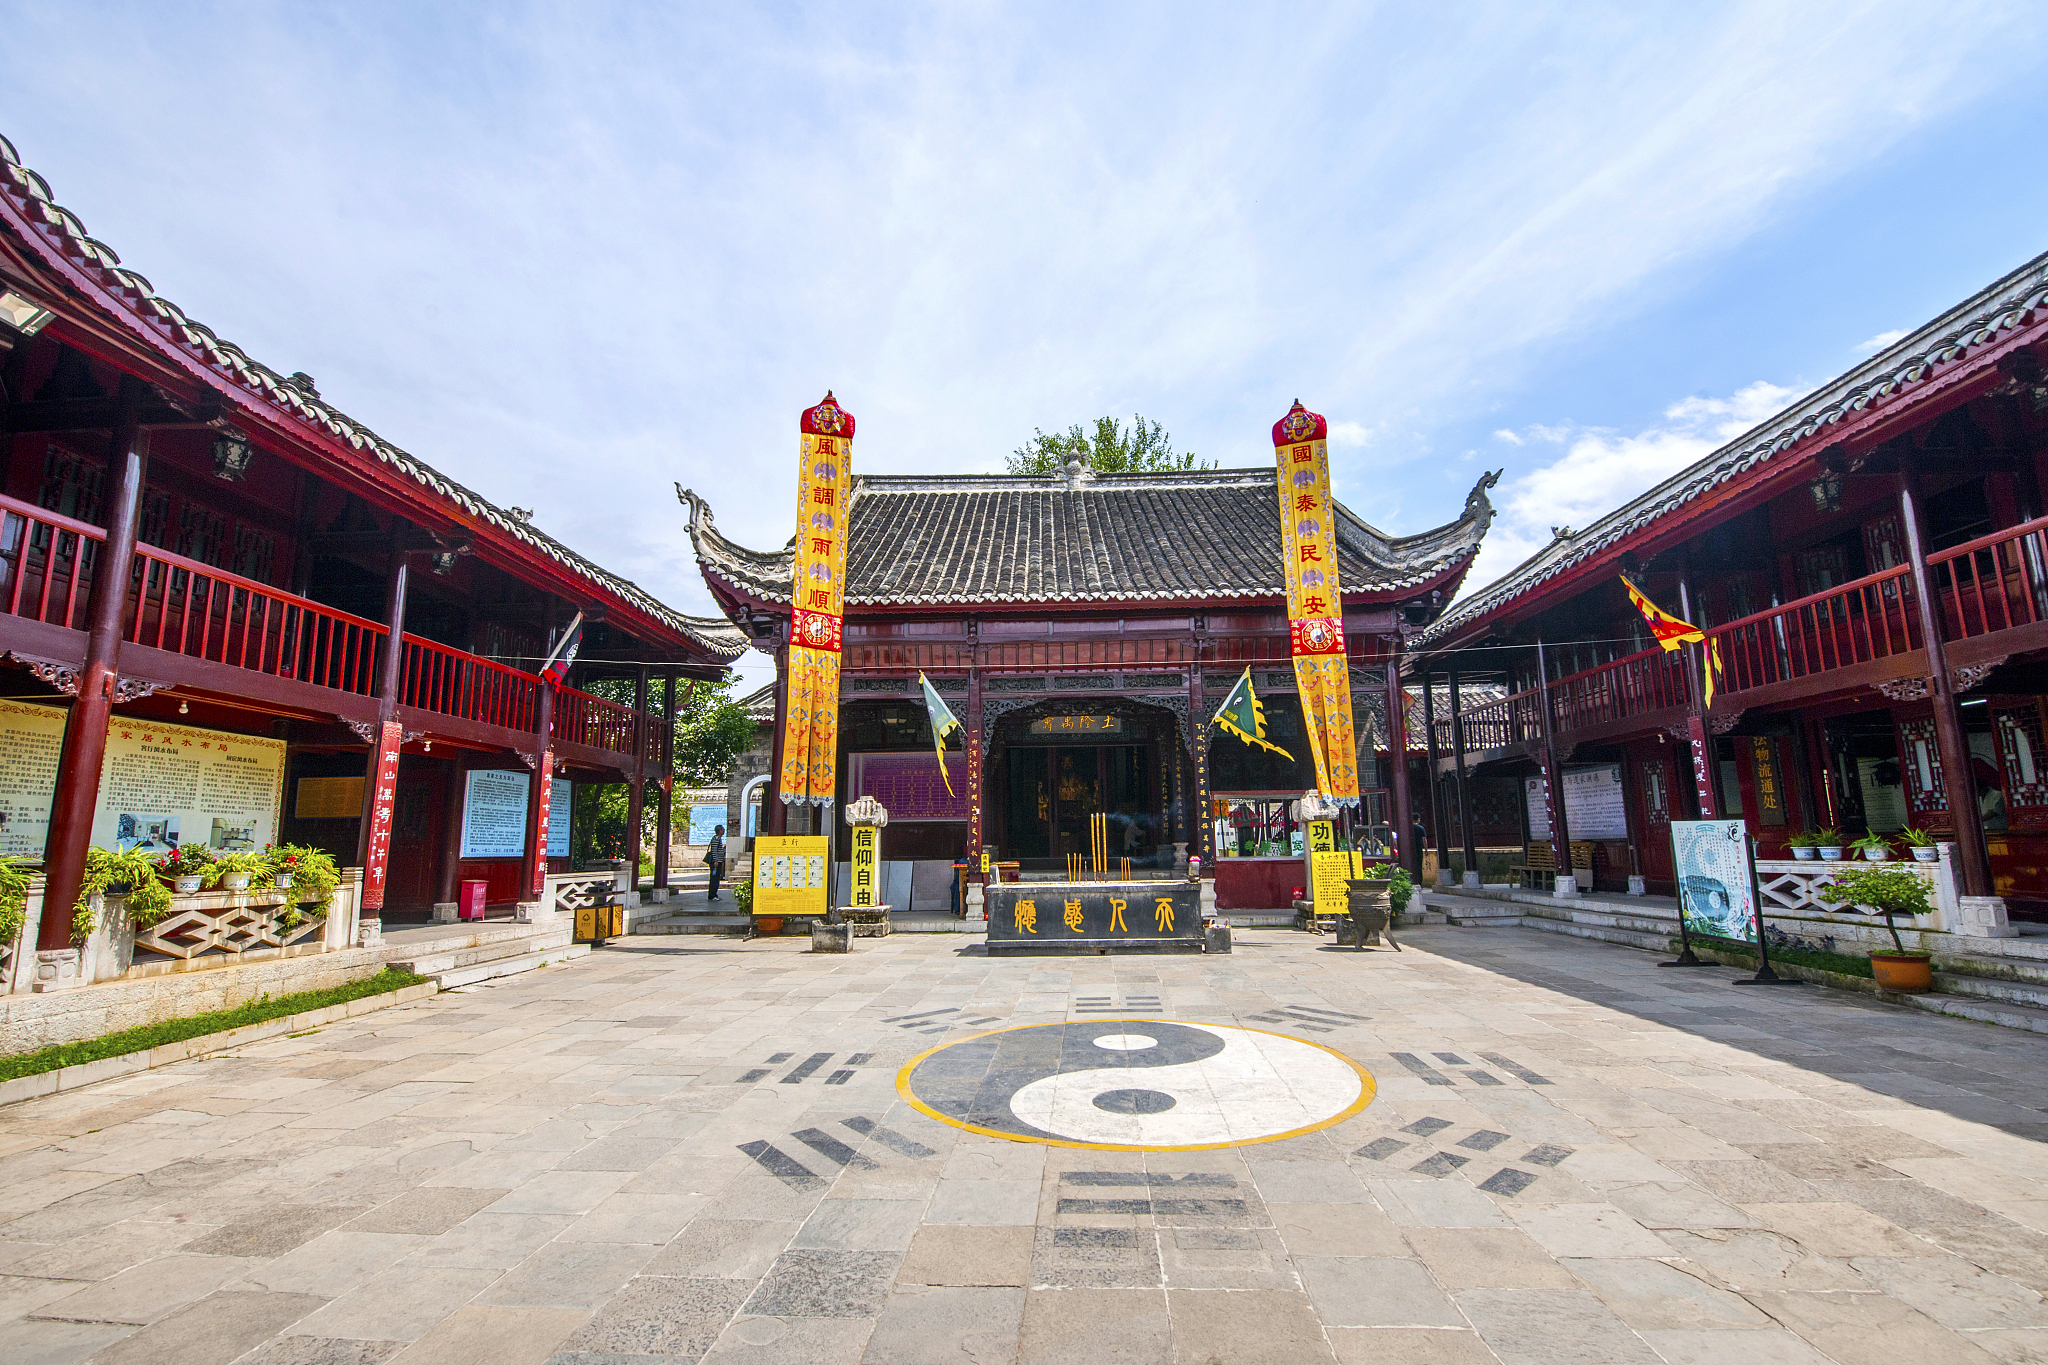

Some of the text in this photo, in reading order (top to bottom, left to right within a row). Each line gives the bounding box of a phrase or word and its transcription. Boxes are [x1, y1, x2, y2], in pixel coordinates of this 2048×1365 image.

[808, 438, 838, 610] 風調雨順
[1293, 444, 1326, 614] 國泰民安
[106, 730, 228, 752] 家居风水布局
[1753, 736, 1778, 809] 法物流通处
[855, 829, 873, 905] 信仰自由
